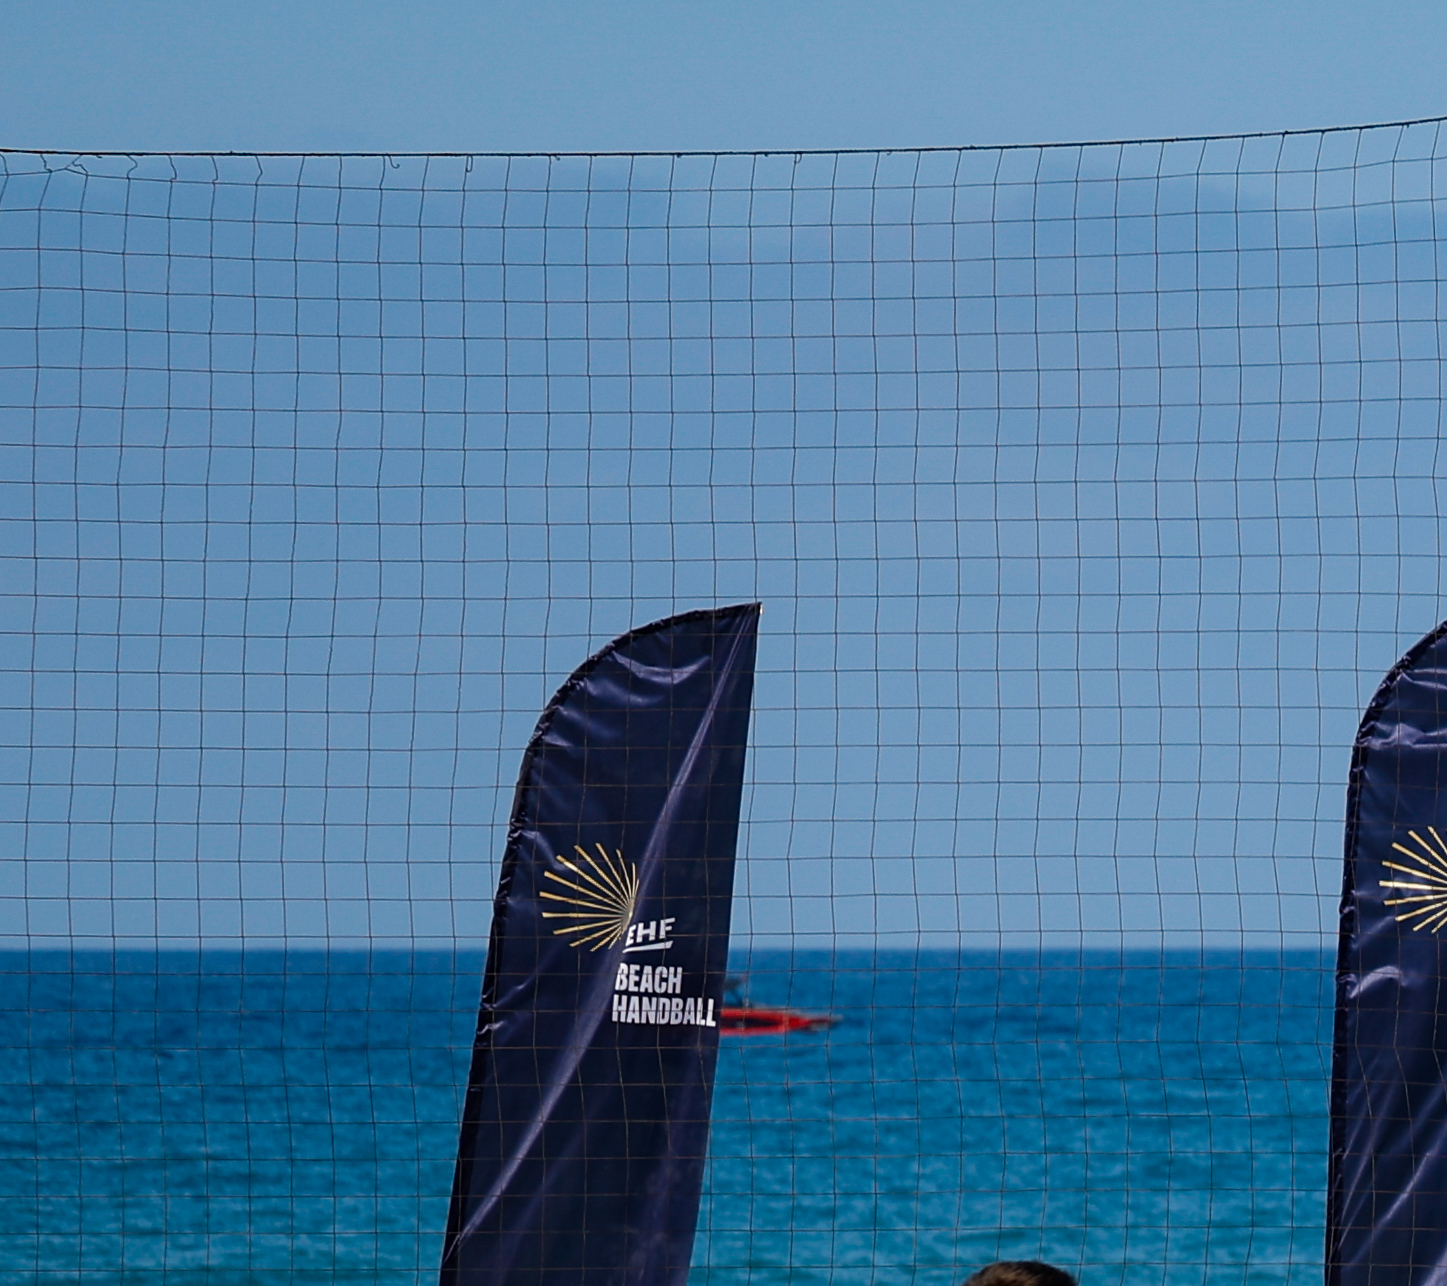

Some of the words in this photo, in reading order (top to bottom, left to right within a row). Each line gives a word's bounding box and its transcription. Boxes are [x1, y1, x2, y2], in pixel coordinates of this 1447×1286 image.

[625, 917, 675, 947] EHF
[615, 963, 682, 994] BEACH
[612, 994, 716, 1027] HANDBALL
